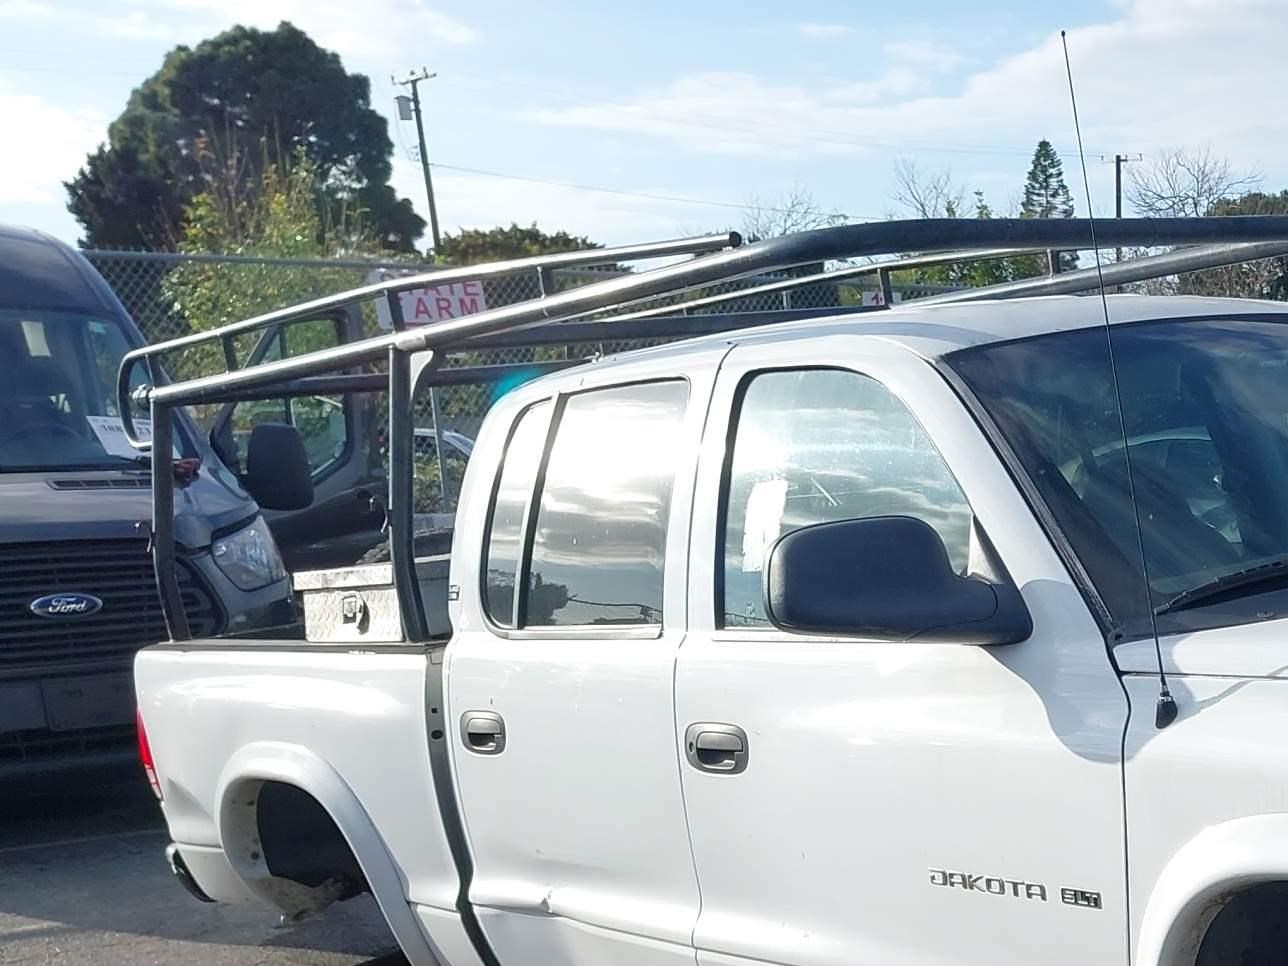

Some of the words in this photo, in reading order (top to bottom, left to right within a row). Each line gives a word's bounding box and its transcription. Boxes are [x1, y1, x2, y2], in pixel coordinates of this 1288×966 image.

[400, 297, 480, 319] ARM
[48, 597, 87, 613] Ford
[928, 868, 1048, 902] DAKOTA
[1061, 887, 1103, 909] SLT
